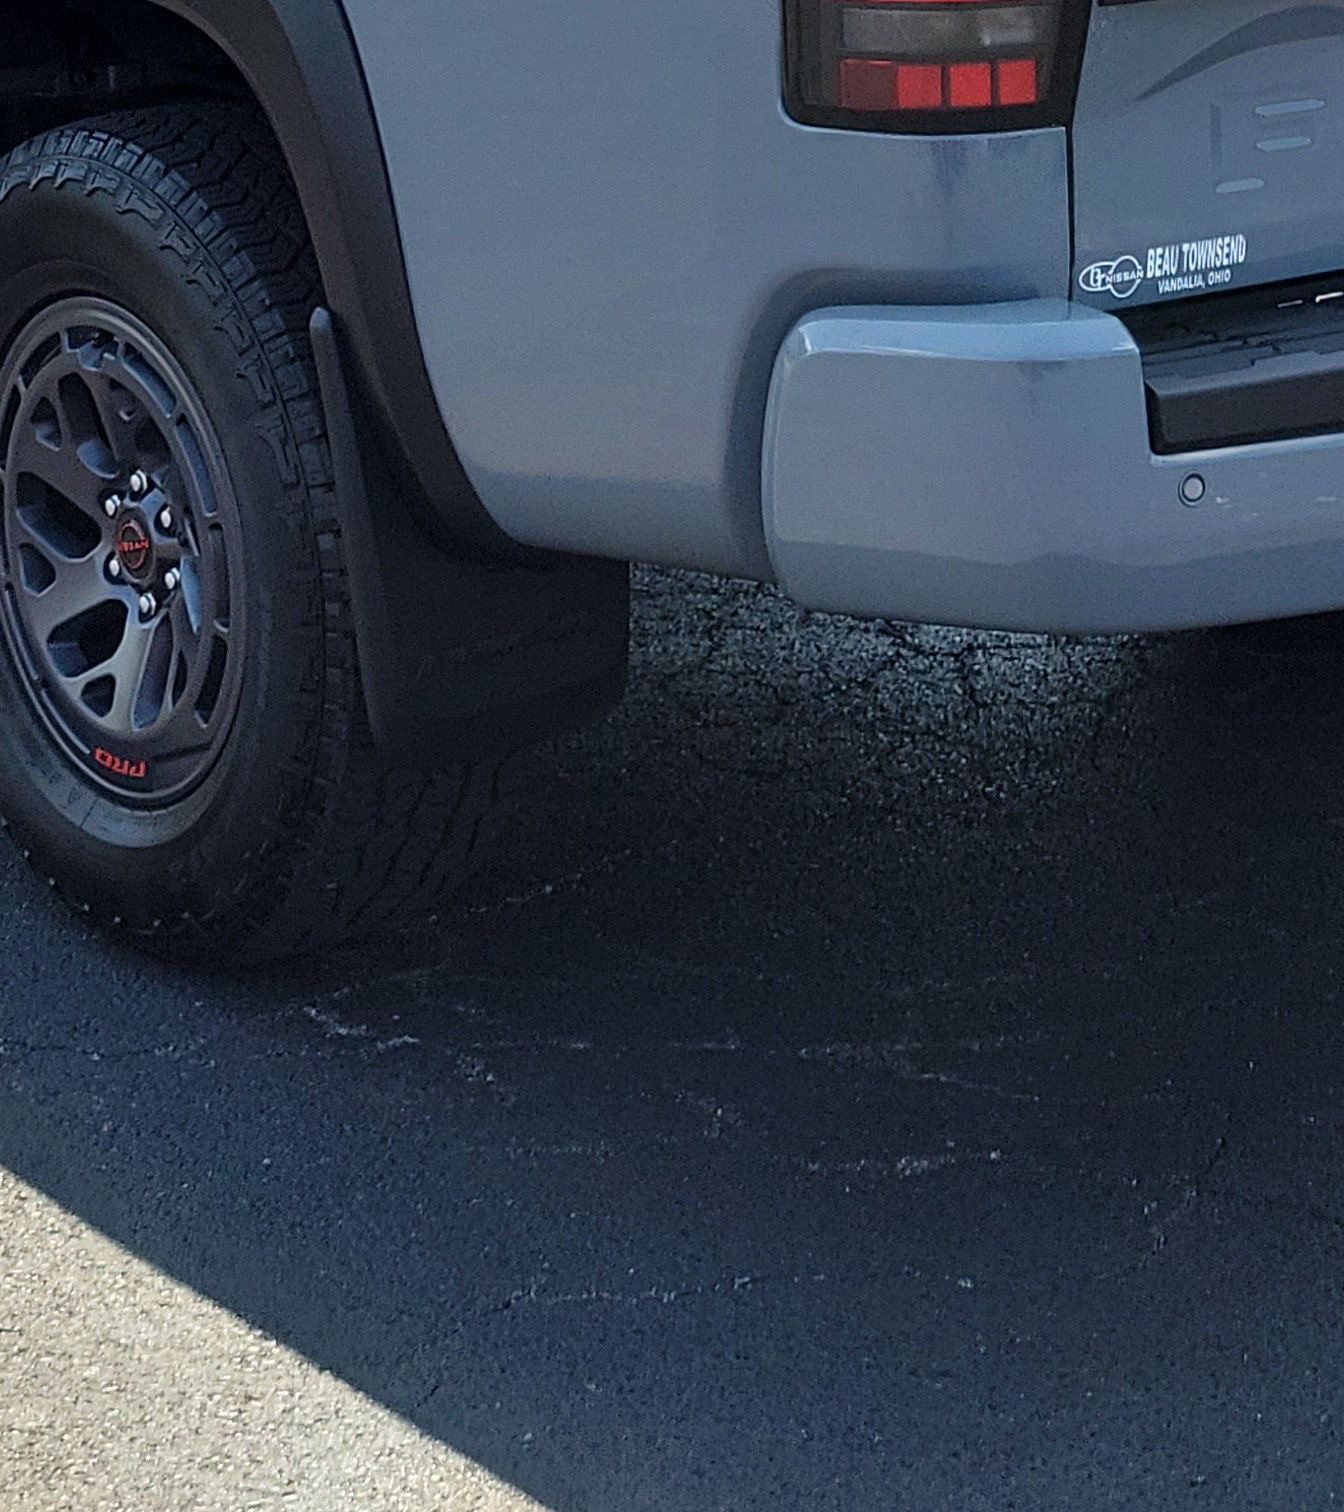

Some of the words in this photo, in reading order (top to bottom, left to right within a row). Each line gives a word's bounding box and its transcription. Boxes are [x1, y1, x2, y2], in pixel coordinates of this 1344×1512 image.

[1146, 245, 1180, 279] BEAU
[1182, 234, 1247, 273] TOWNSEND
[1105, 269, 1144, 285] NISSAN
[1157, 273, 1206, 295] VANDALIA,
[1207, 268, 1232, 286] OHIO
[95, 746, 146, 778] PRO
